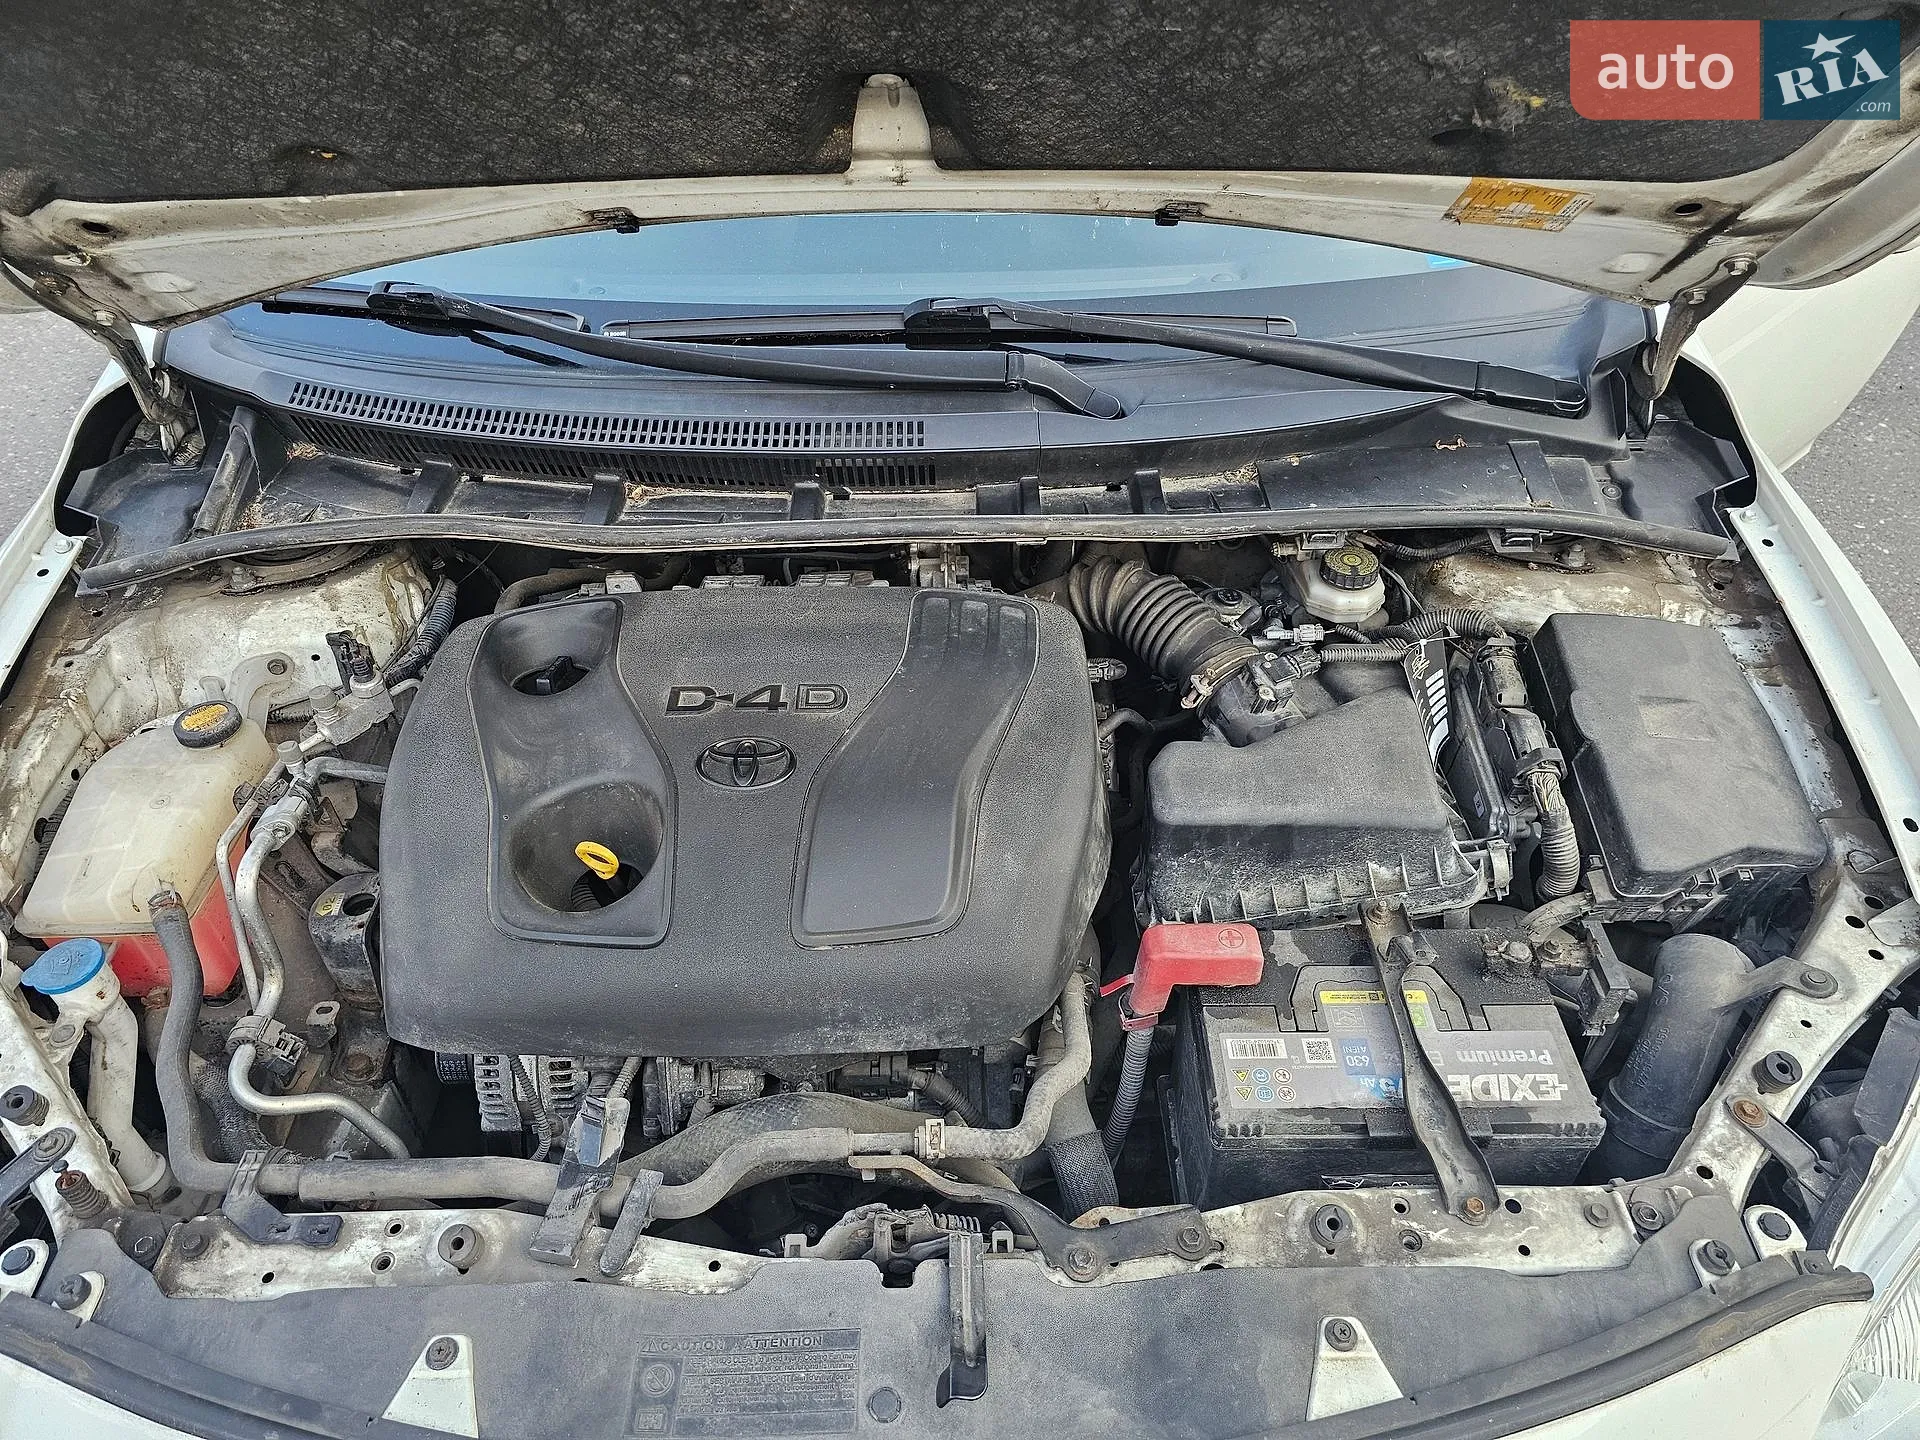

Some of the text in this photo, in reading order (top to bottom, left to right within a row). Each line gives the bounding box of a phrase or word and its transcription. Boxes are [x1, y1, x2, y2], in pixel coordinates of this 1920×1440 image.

[665, 684, 850, 716] D-4D
[1346, 1055, 1370, 1067] 630
[1456, 1049, 1554, 1066] Premium
[1359, 1077, 1376, 1088] Ah
[1448, 1073, 1568, 1101] EXIDE
[660, 1336, 823, 1351] CAUTION ATTENTION
